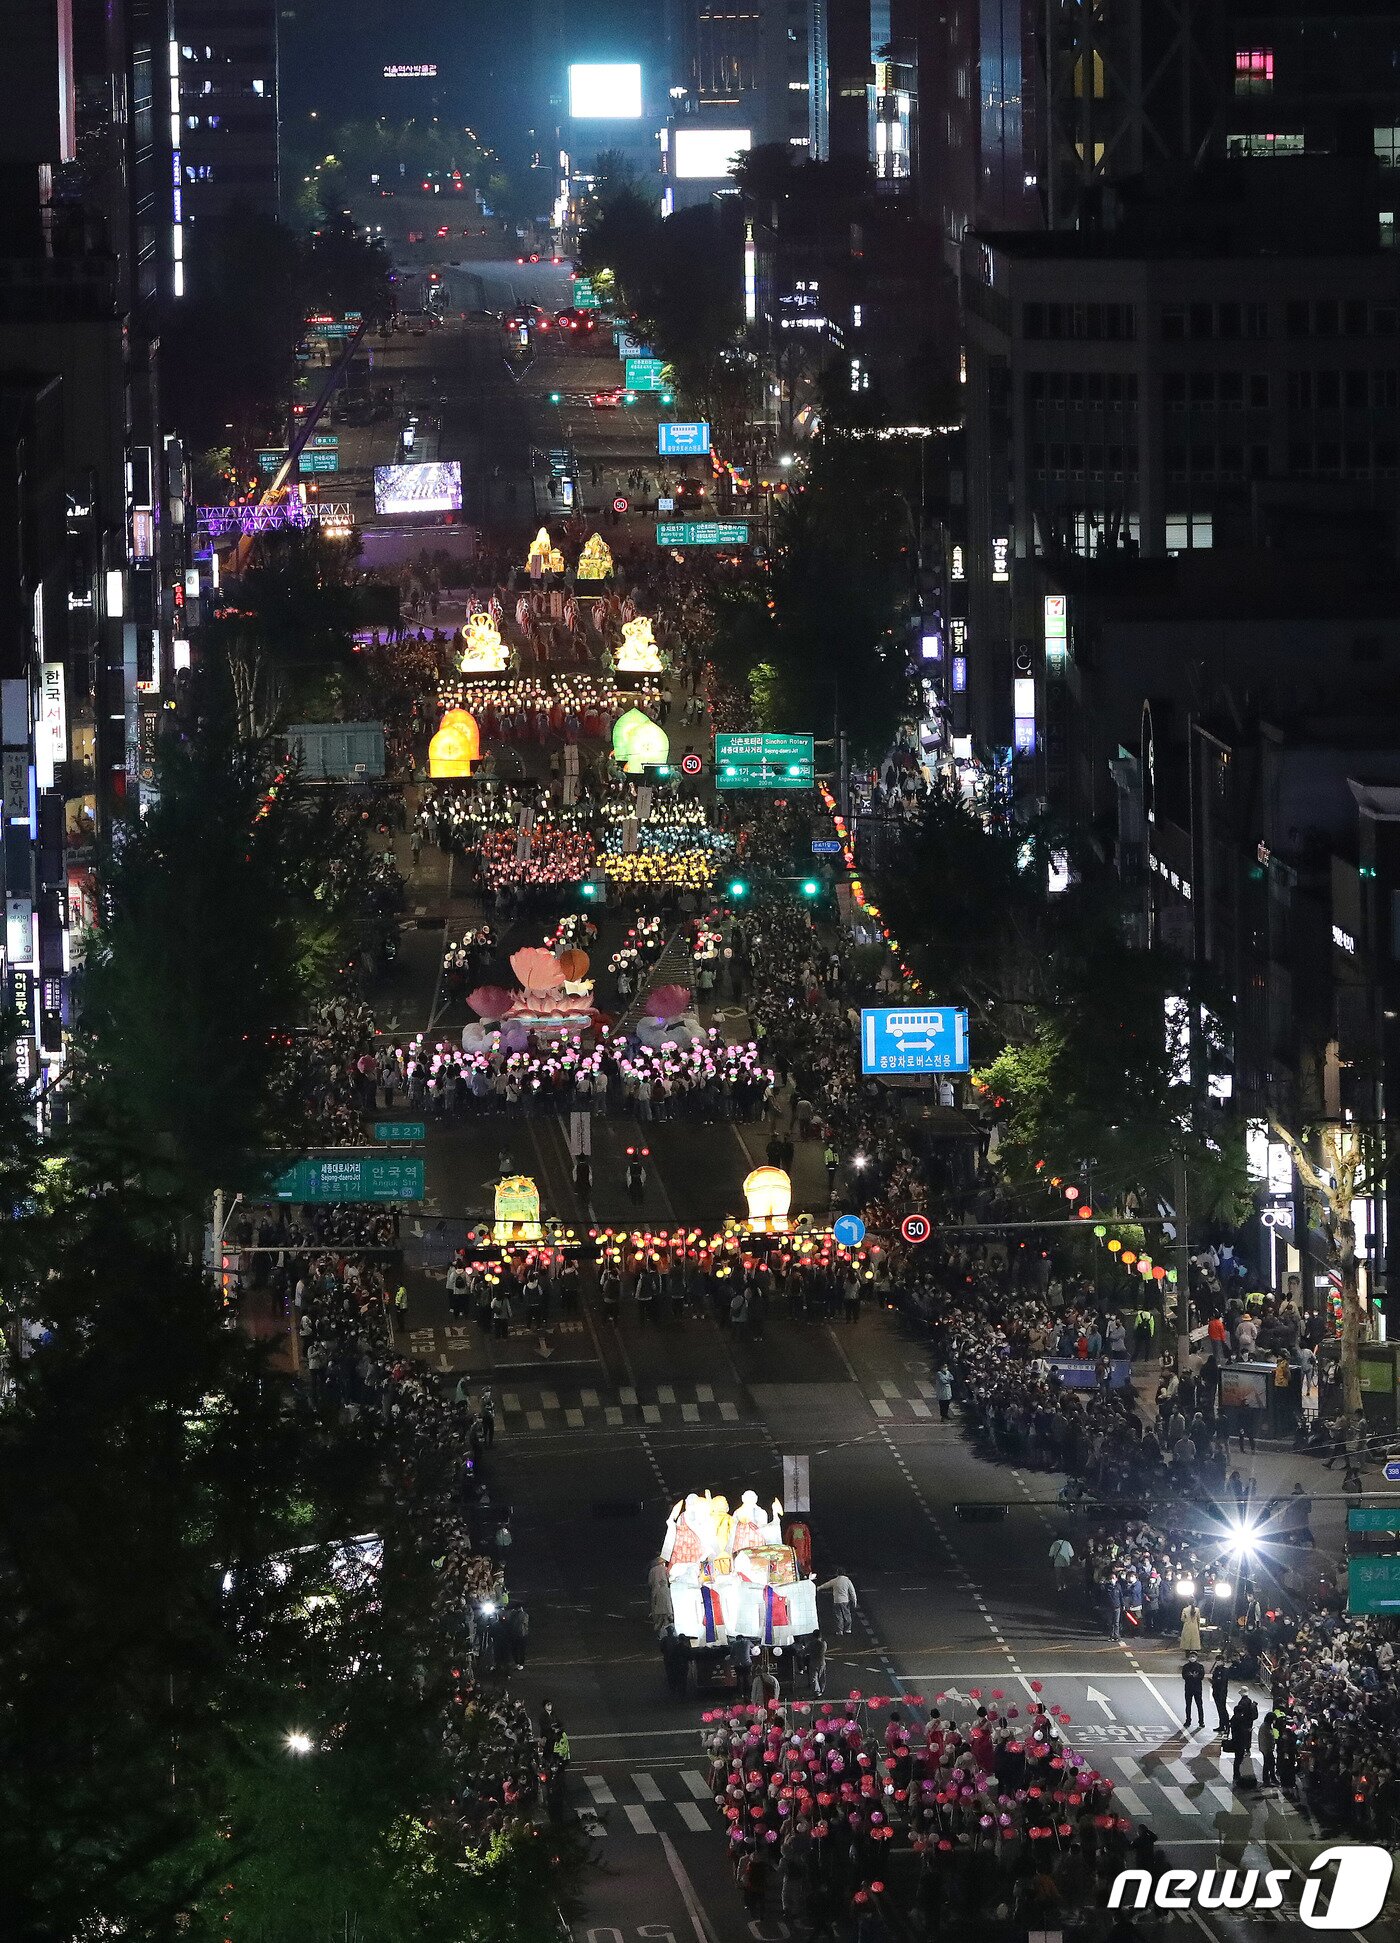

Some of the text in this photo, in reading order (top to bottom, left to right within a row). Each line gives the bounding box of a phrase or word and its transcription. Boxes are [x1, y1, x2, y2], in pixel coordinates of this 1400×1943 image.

[992, 538, 1009, 546] LED
[174, 585, 184, 605] BAR
[954, 627, 964, 653] 보청기
[729, 737, 763, 746] 신촌로터리
[789, 738, 809, 746] Rotary
[720, 746, 763, 755] 세종대로사거리
[686, 760, 698, 769] 50
[9, 764, 24, 810] 세무사
[880, 1054, 951, 1068] 중앙차로버스전용
[378, 1126, 421, 1137] 종로2가
[320, 1162, 361, 1174] 세종대로사거리
[371, 1166, 418, 1179] 안국역
[321, 1182, 361, 1192] 종로1가
[907, 1222, 924, 1236] 50
